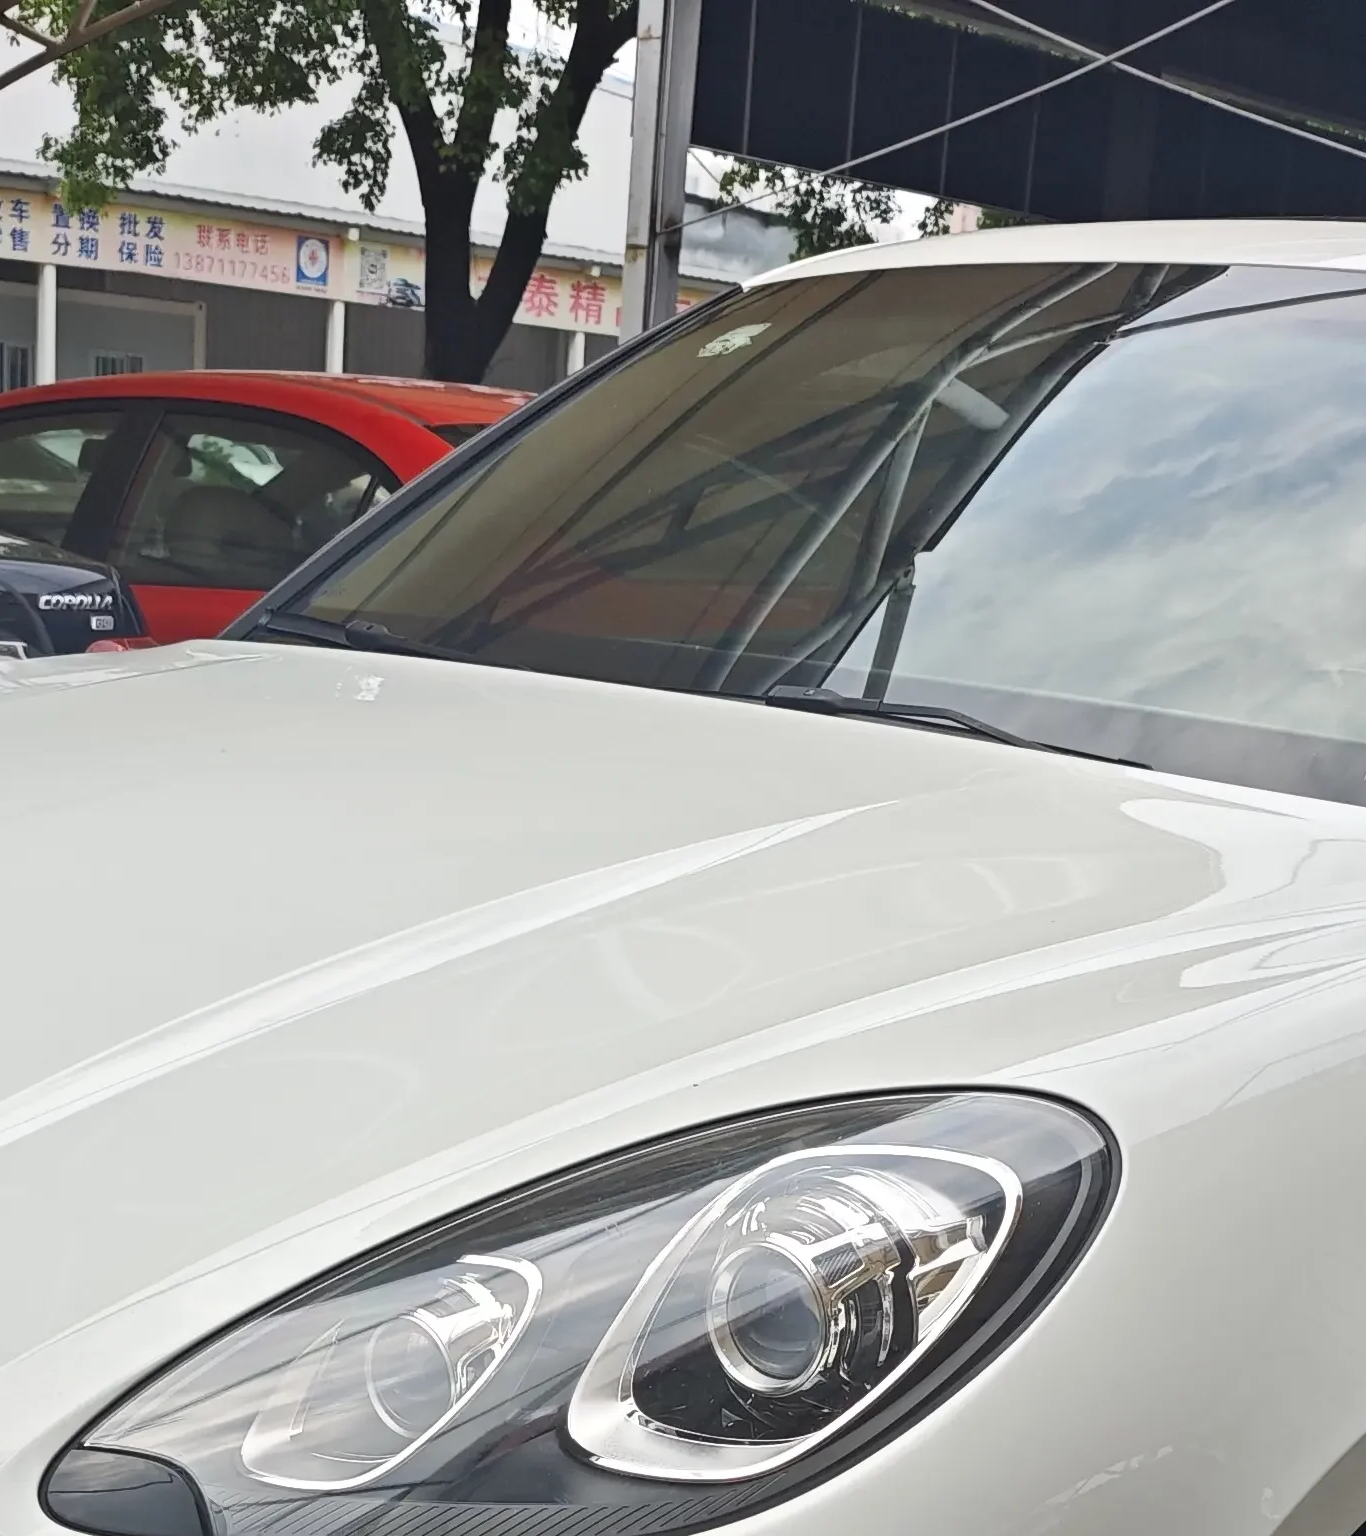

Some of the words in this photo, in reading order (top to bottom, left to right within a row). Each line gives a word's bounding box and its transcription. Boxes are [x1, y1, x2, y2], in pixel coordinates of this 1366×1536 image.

[118, 211, 166, 241] 批发
[51, 232, 99, 261] 分期
[118, 240, 165, 268] 保险
[174, 252, 291, 284] 13871177456
